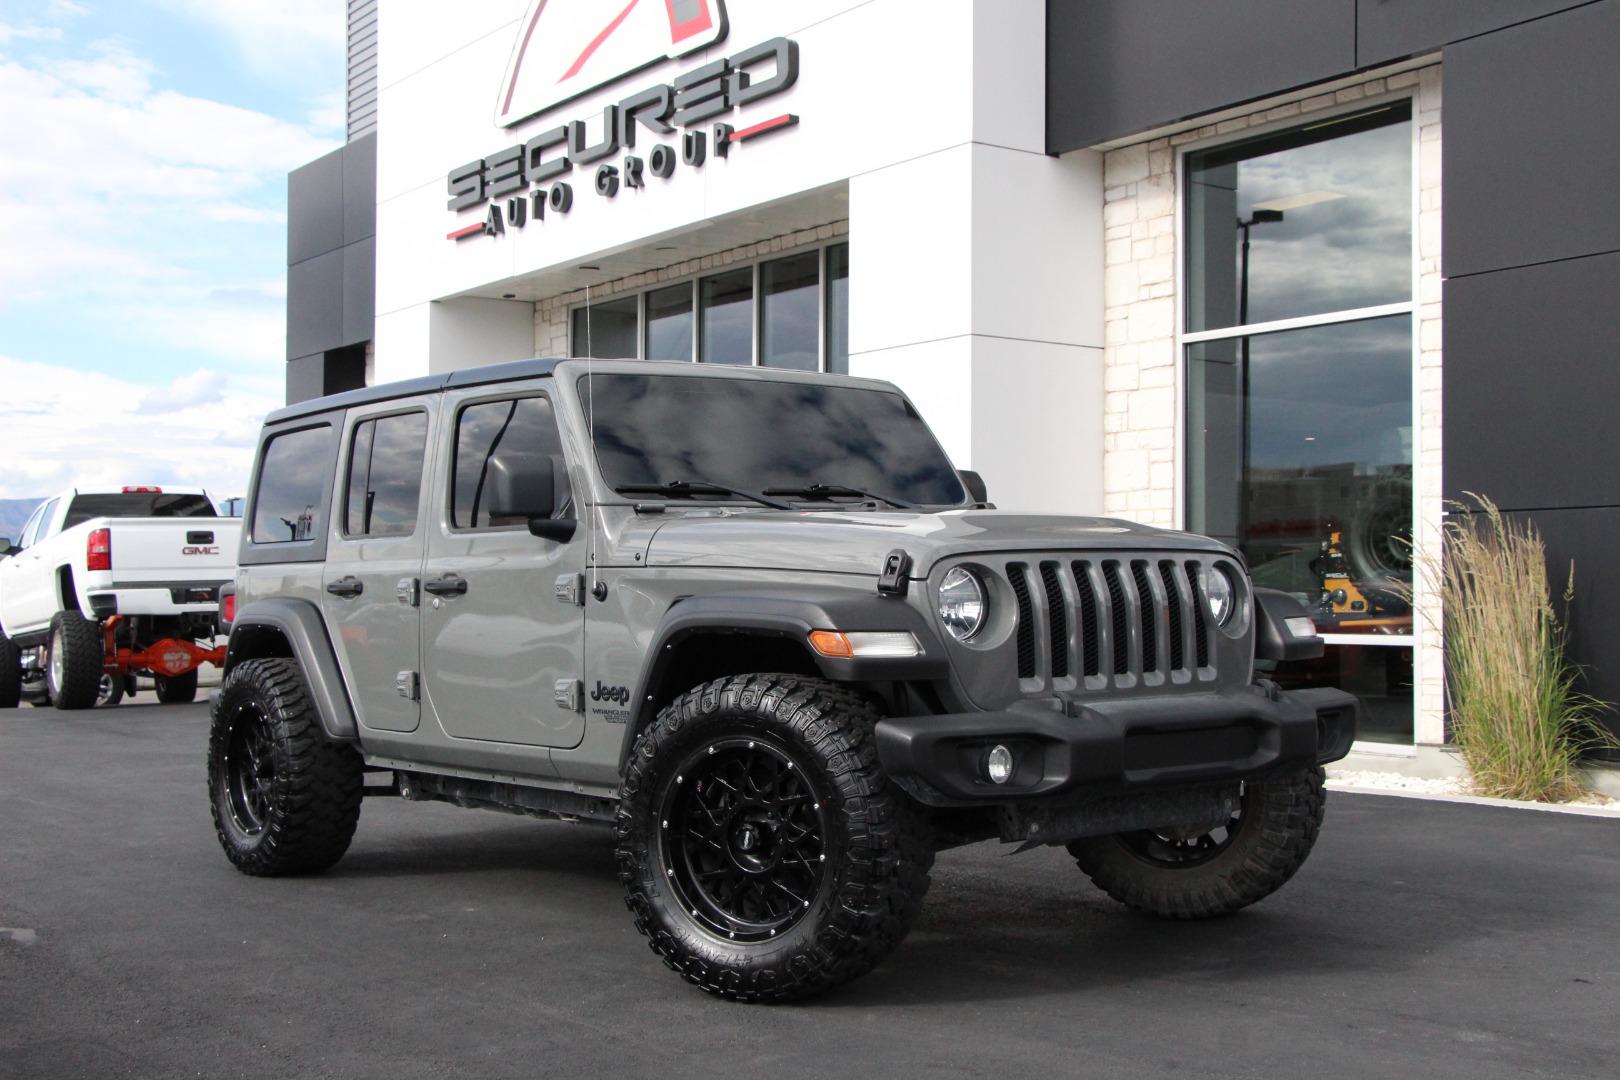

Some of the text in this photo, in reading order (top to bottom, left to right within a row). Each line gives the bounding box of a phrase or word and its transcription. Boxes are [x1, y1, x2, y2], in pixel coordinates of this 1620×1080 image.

[447, 36, 800, 211] SECURED
[484, 122, 735, 237] AUTO GROUP
[182, 546, 220, 555] GMC
[590, 680, 630, 706] Jeep
